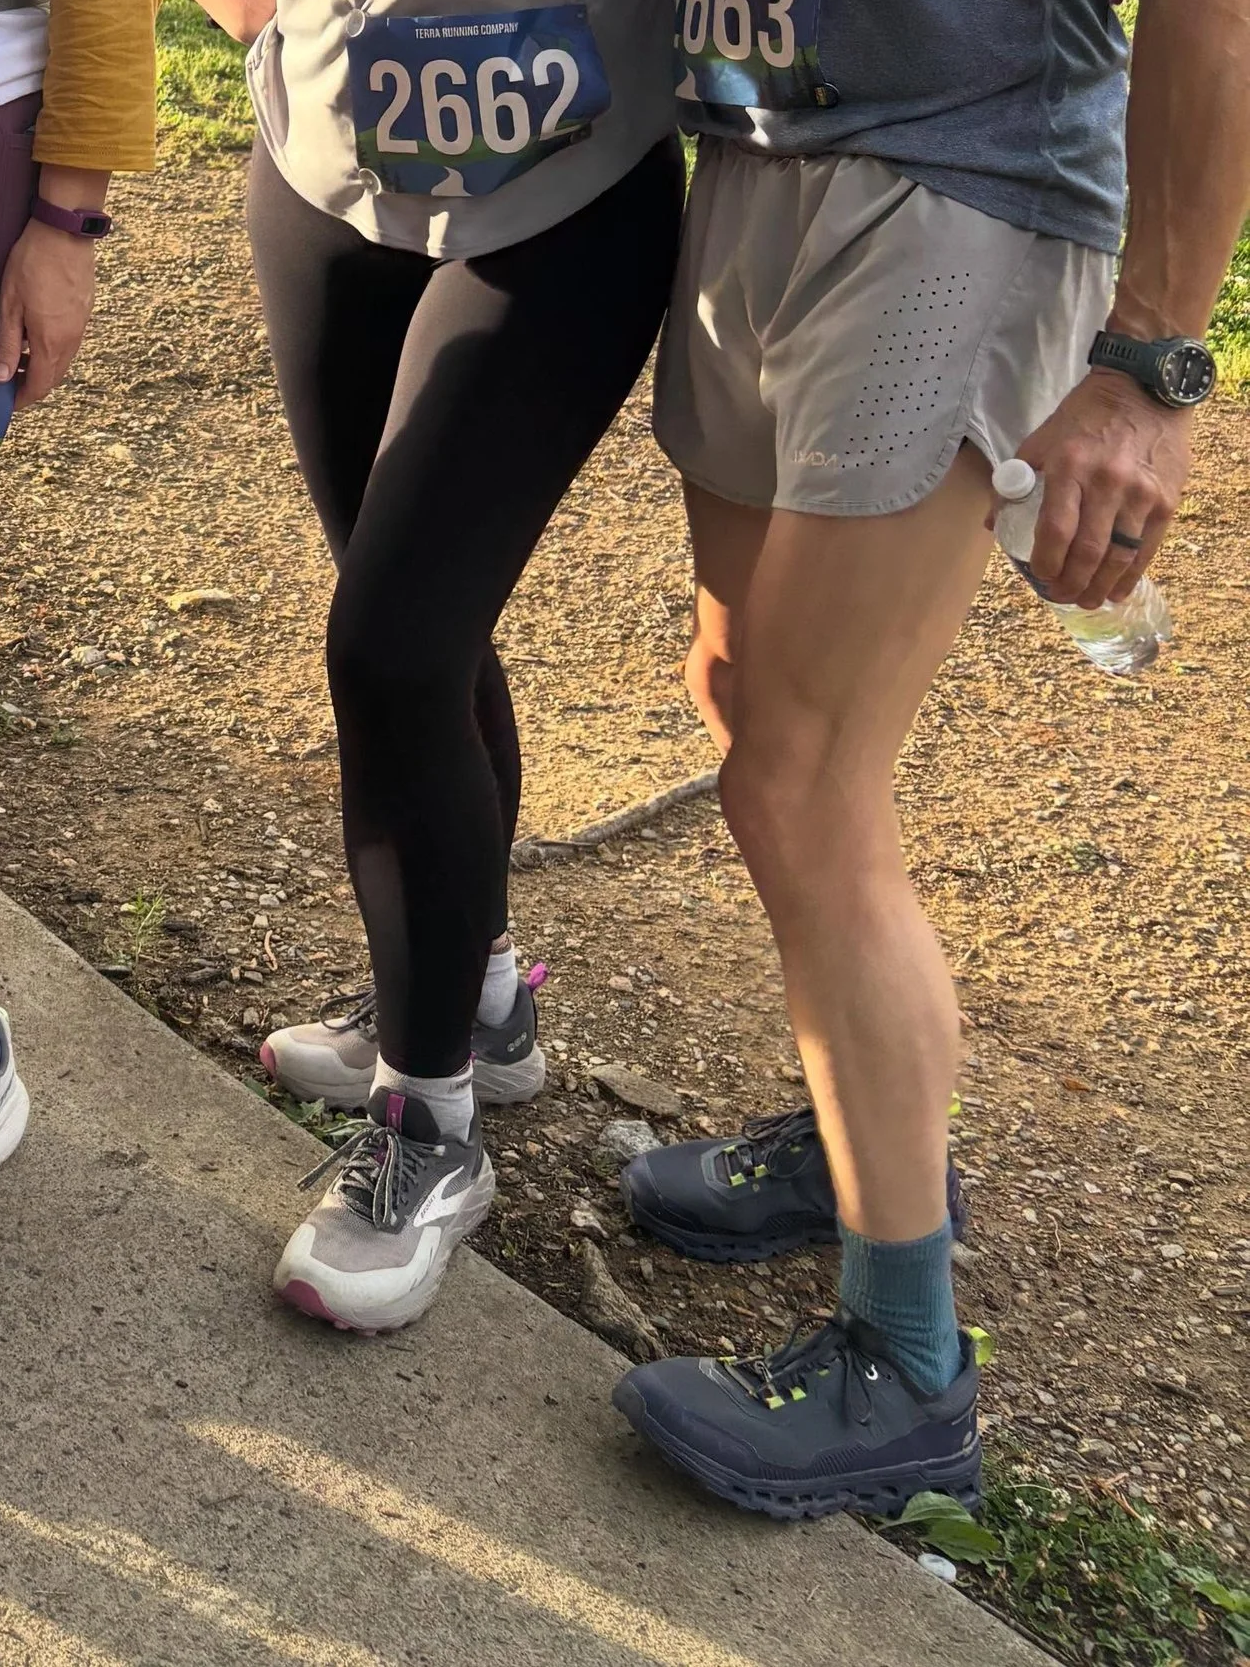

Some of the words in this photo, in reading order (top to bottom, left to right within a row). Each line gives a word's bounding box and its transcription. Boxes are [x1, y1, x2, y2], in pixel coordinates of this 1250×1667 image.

[415, 26, 441, 40] TERRA
[441, 24, 480, 39] RUNNING
[480, 21, 519, 37] COMPANY
[368, 48, 580, 156] 2662
